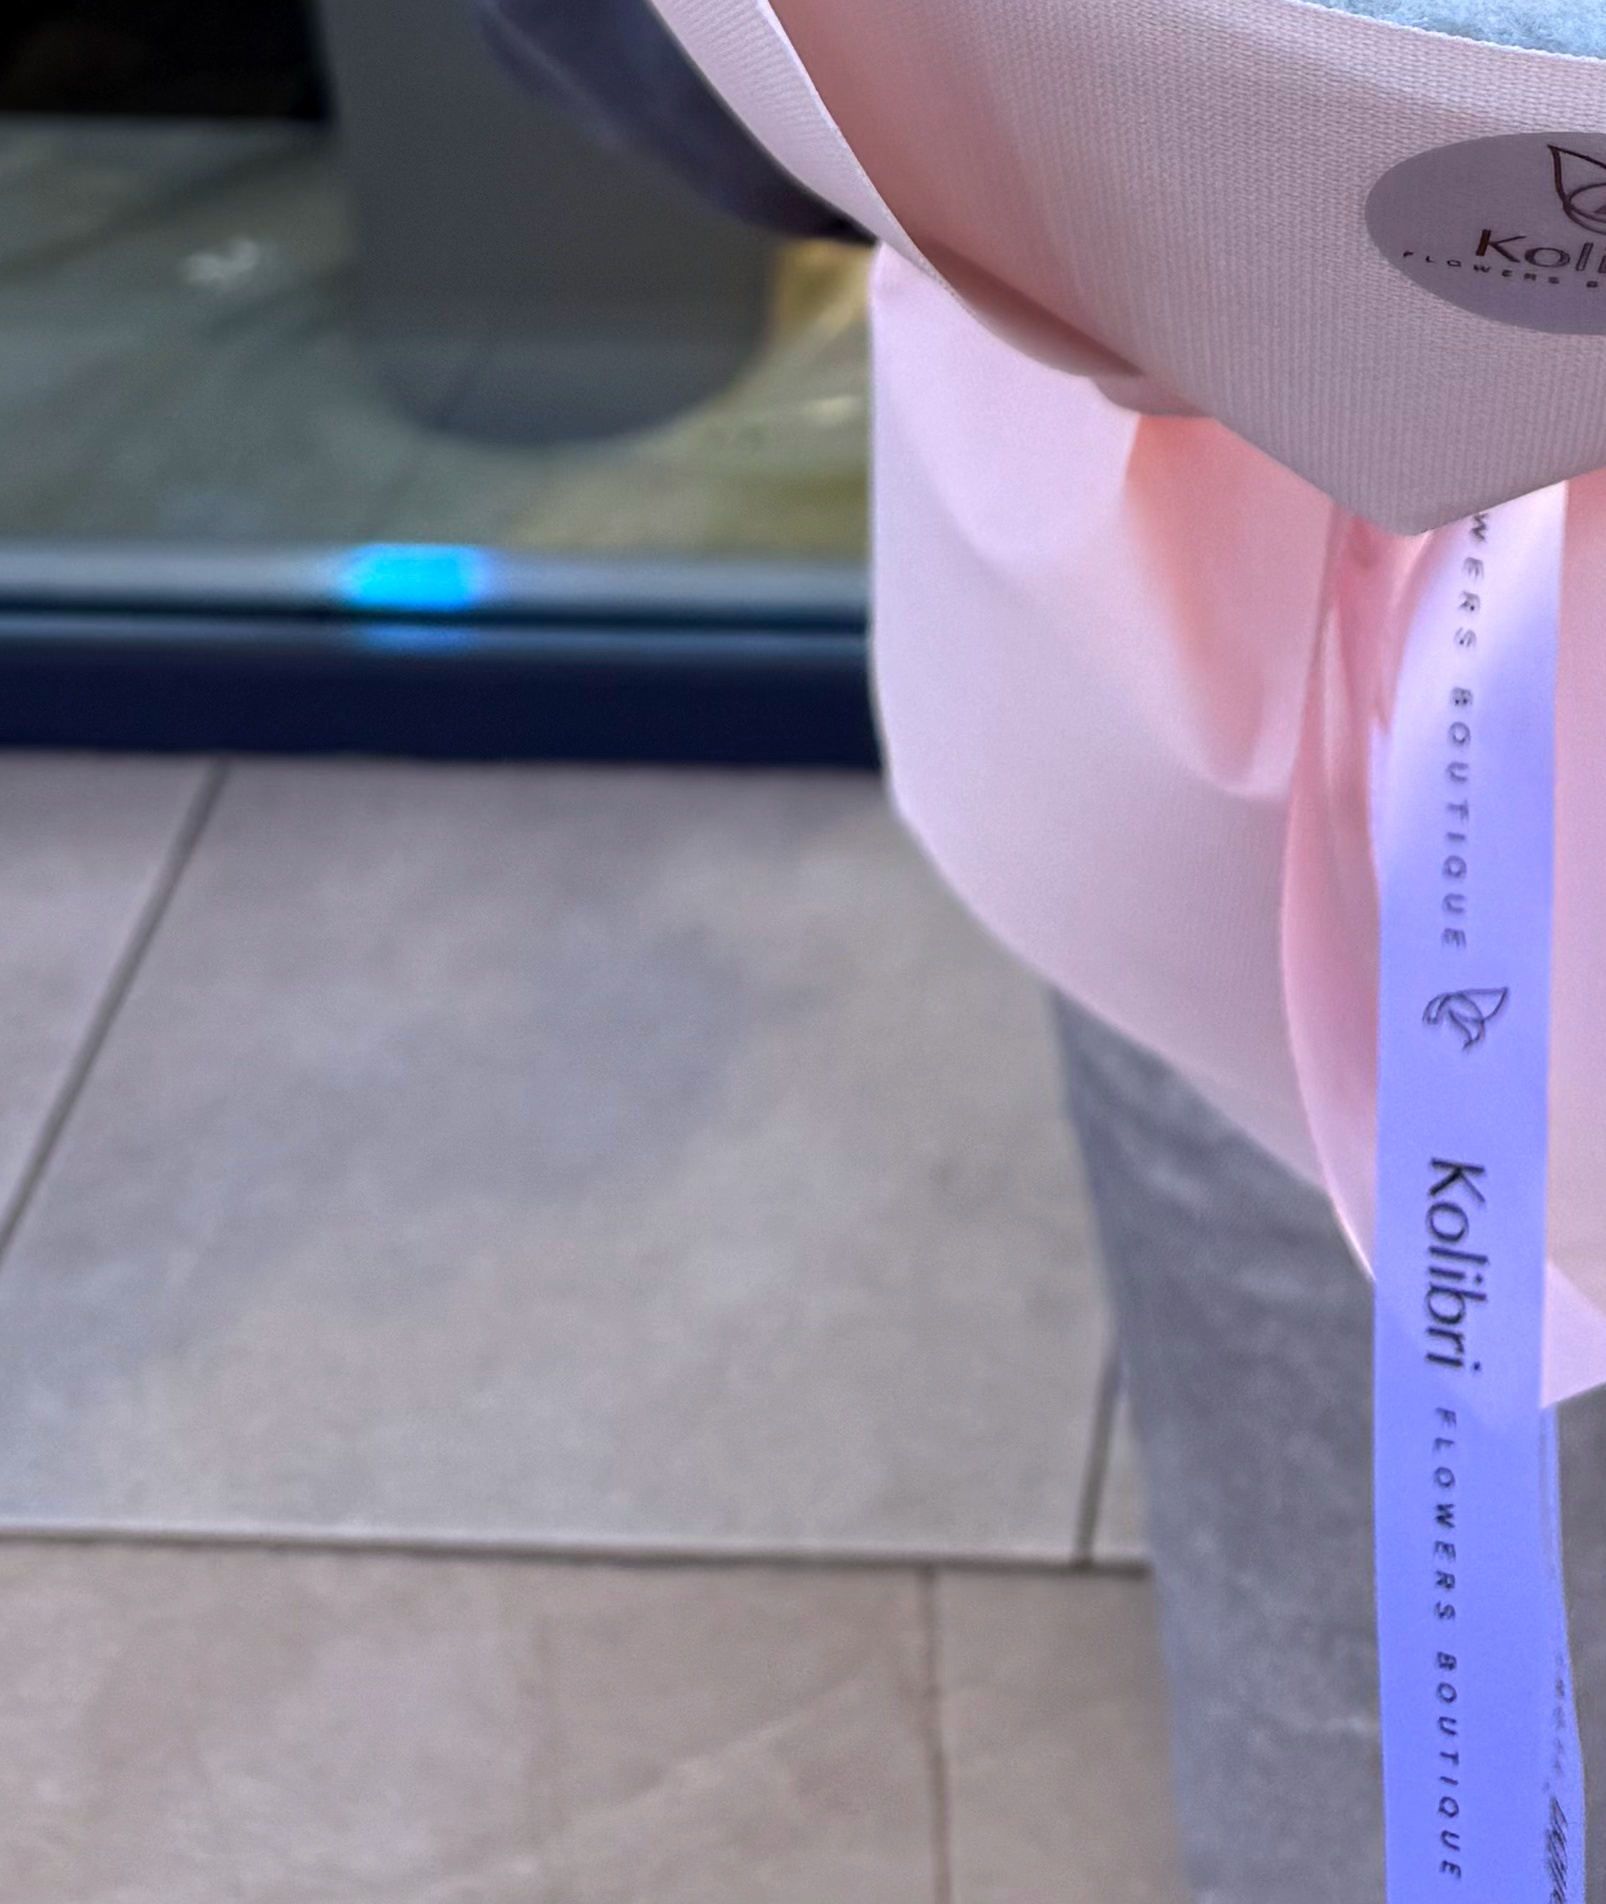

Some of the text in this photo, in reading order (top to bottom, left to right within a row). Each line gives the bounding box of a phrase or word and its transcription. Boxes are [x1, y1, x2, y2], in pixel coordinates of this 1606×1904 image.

[1402, 251, 1560, 284] FLOWERS
[1441, 512, 1488, 948] WERS BOUTIQUE
[1425, 1157, 1489, 1881] Kolibri FLOWERS BOUTIQUE
